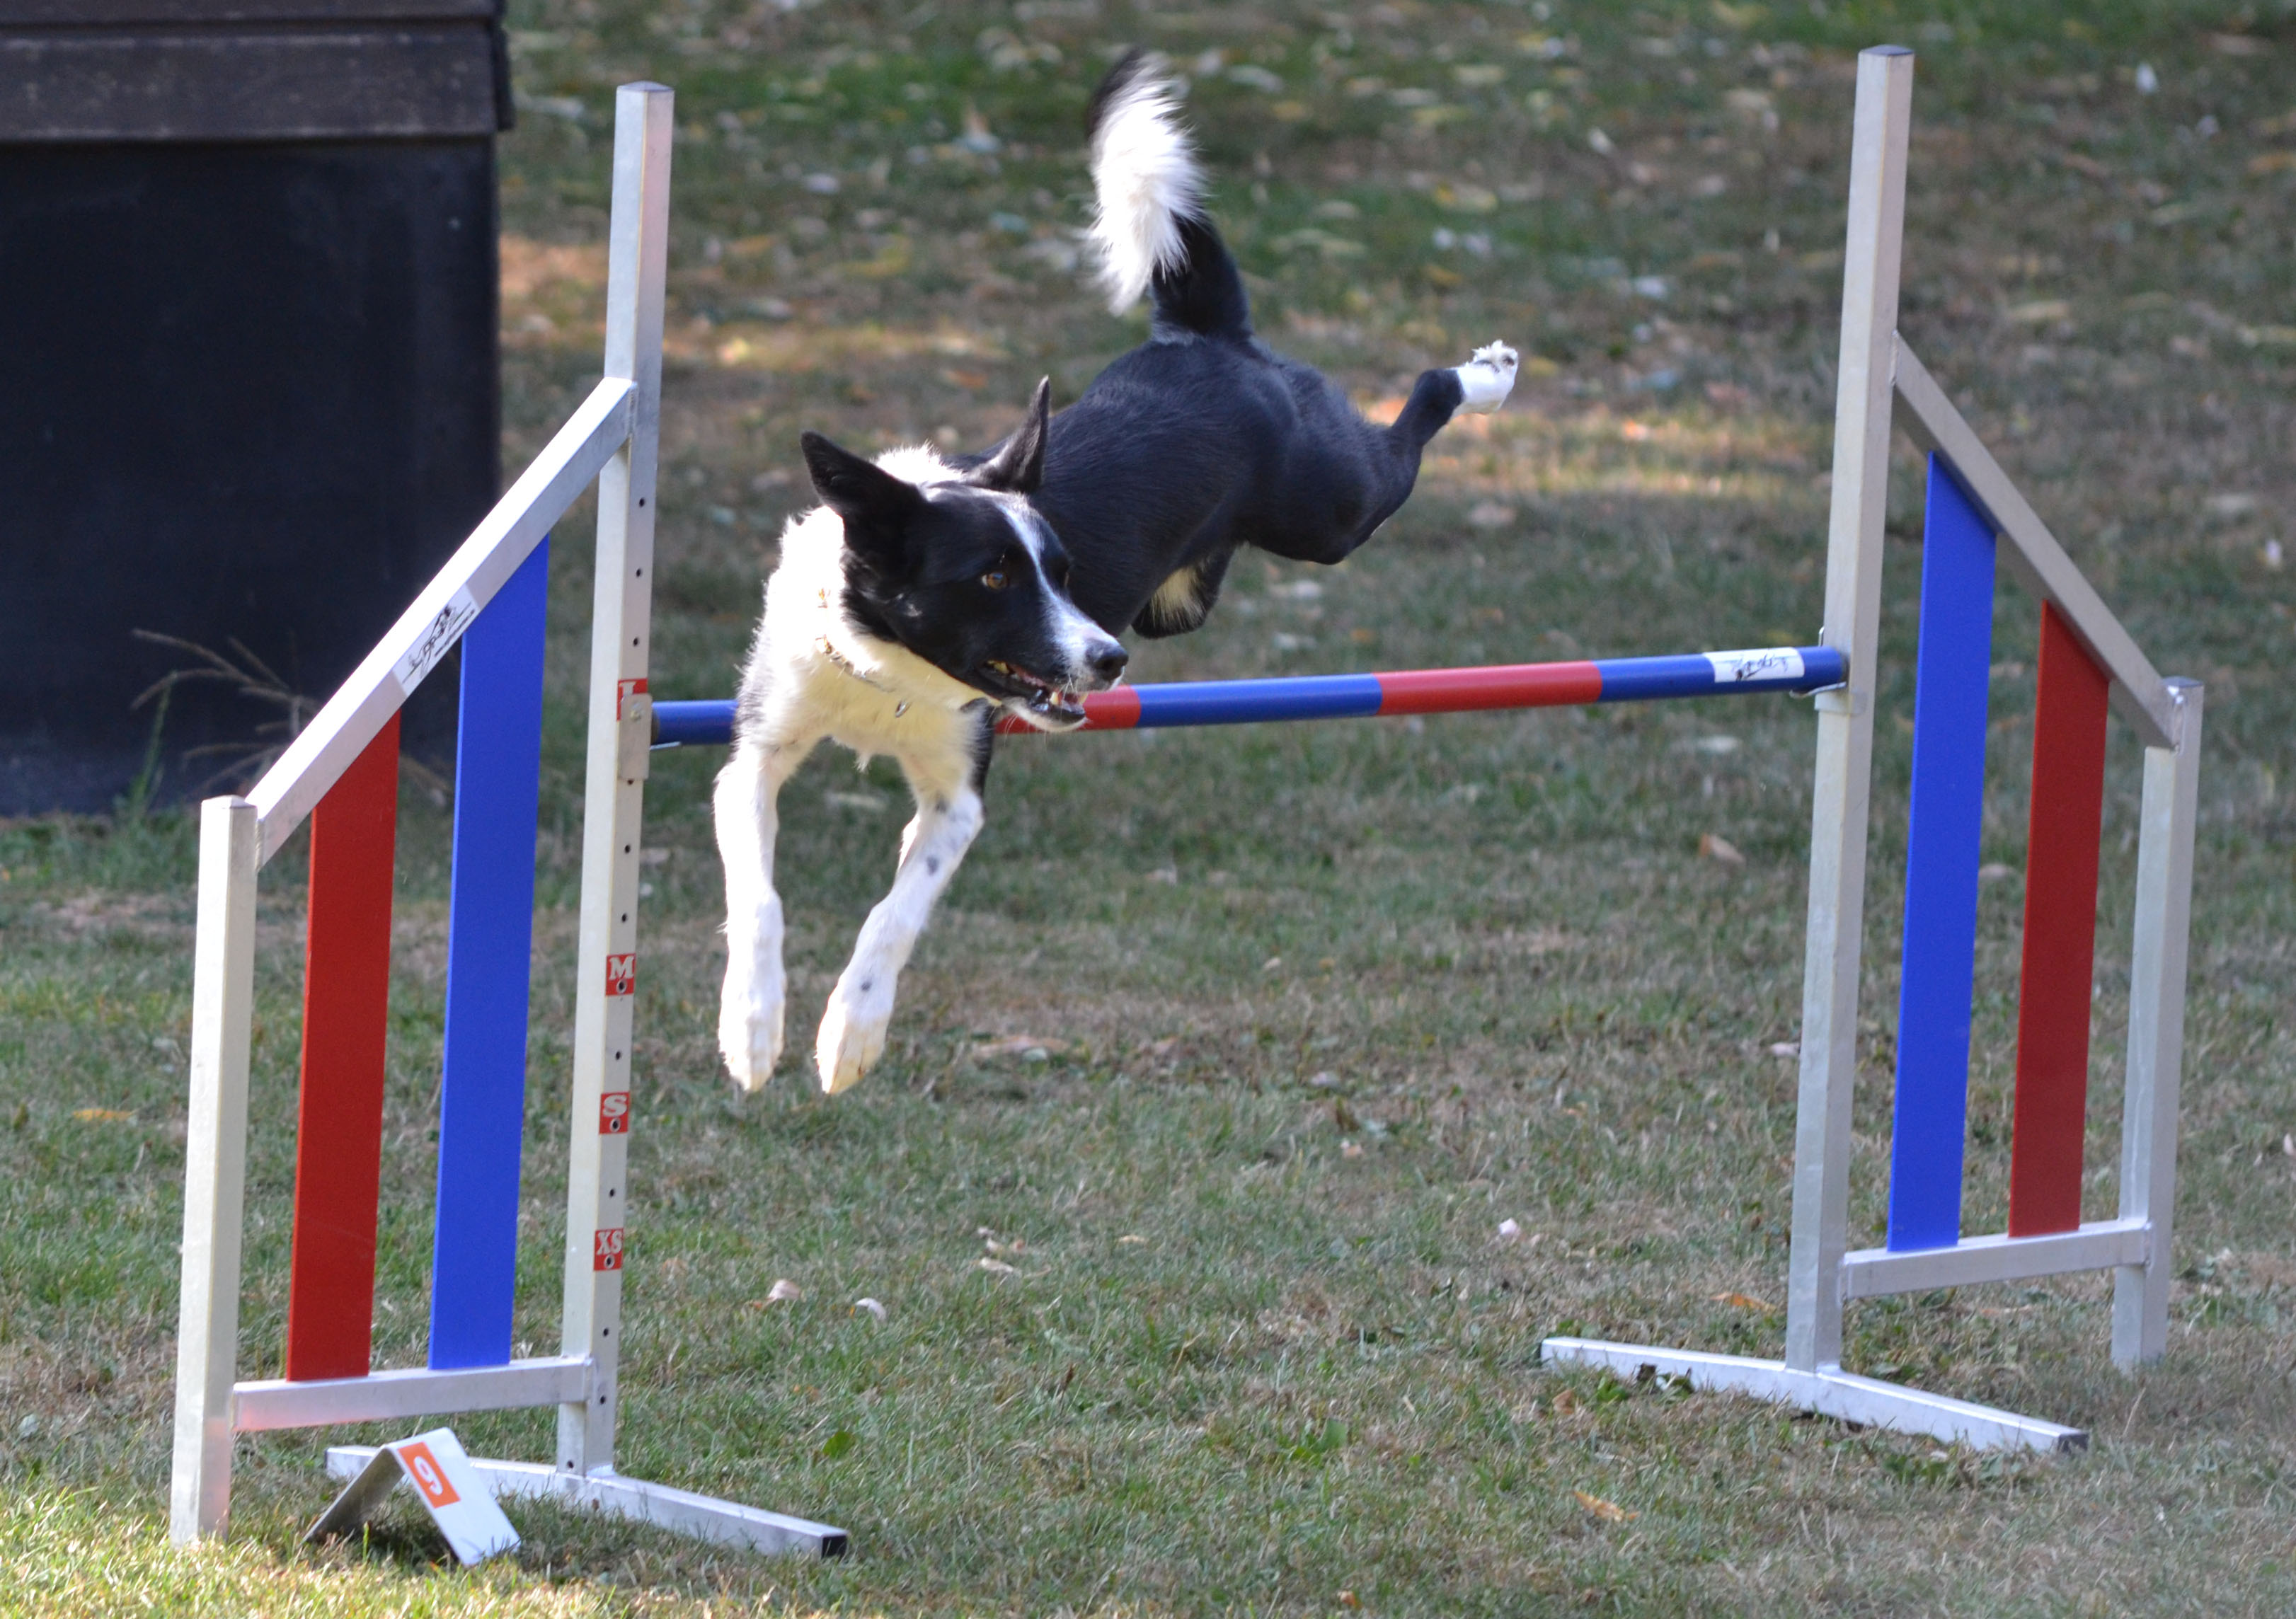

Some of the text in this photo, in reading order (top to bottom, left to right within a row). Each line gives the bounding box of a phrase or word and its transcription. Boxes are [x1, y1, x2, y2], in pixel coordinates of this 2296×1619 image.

[609, 956, 634, 980] M
[603, 1095, 627, 1117] S
[597, 1231, 622, 1255] XS
[413, 1456, 443, 1496] 9
